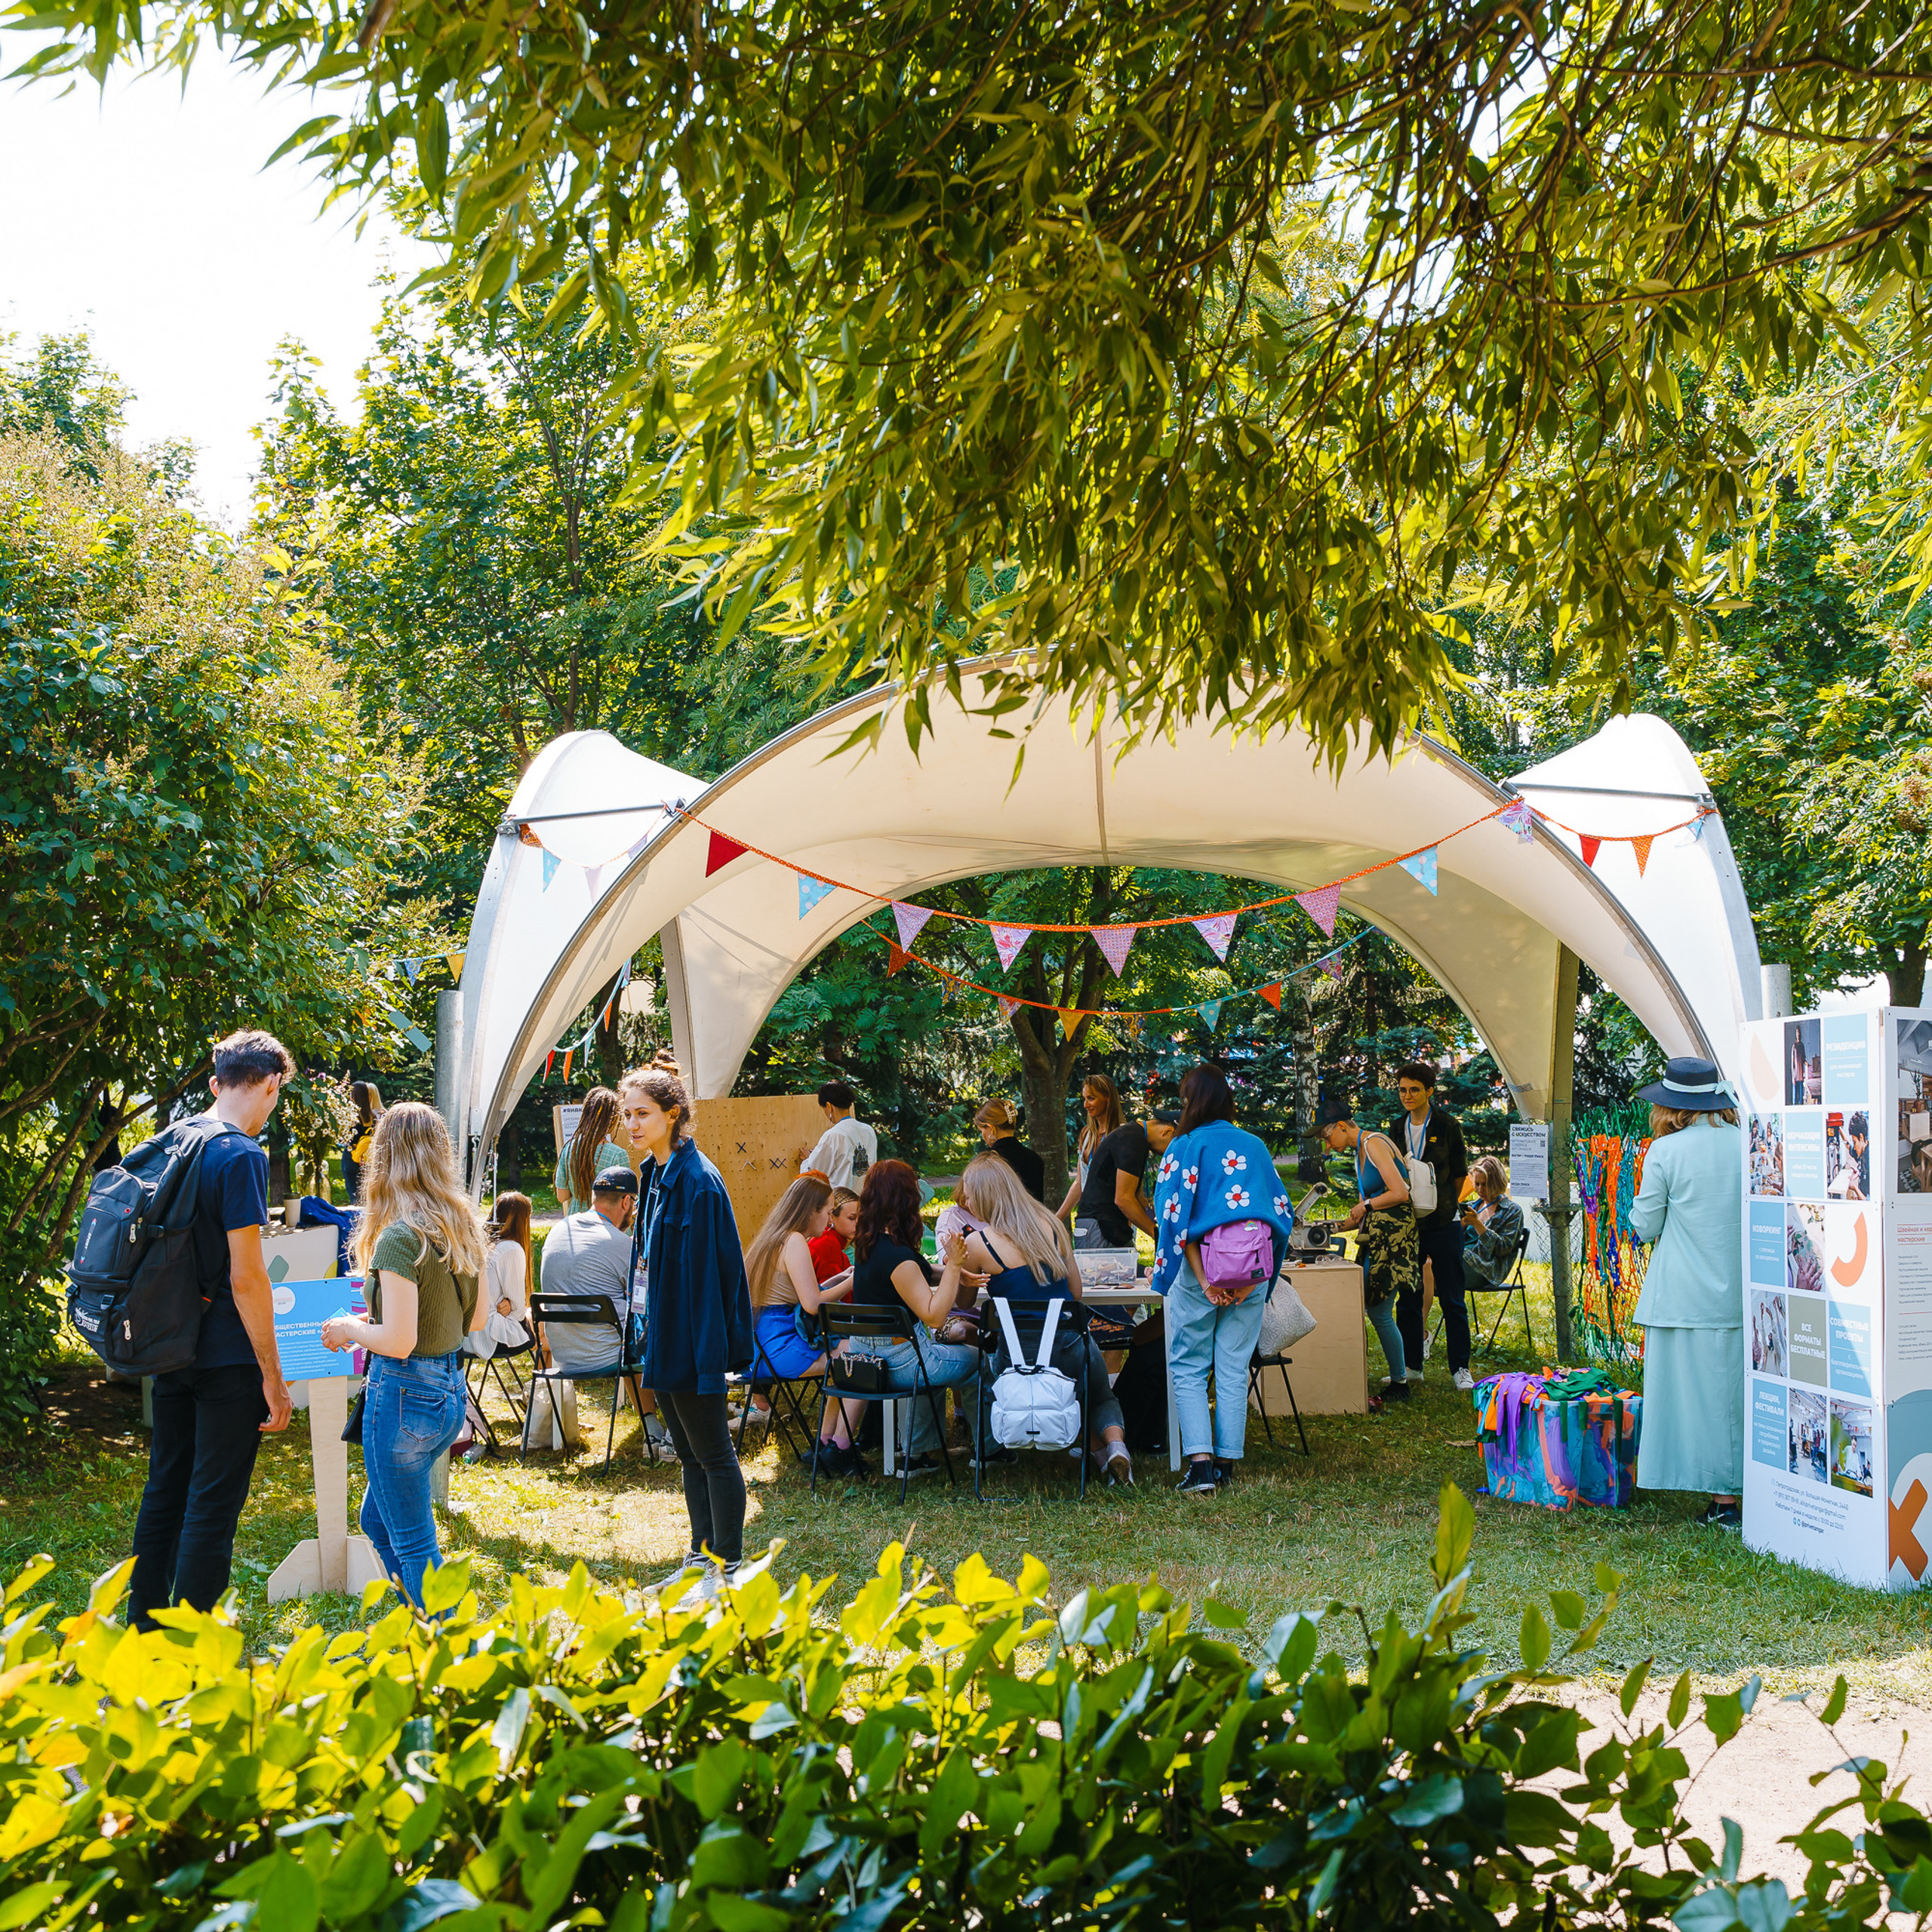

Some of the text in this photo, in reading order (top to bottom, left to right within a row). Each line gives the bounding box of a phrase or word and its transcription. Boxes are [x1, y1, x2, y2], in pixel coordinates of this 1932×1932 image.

[1826, 1041, 1866, 1052] РЕЗИДЕНЦИЯ
[1787, 1131, 1822, 1141] ОБУЧАЮЩИЕ
[1788, 1143, 1820, 1152] ИНТЕНСИВЫ
[1752, 1224, 1782, 1235] КОВОРКИНГ
[275, 1321, 325, 1331] БЩЕСТВЕННЫ
[1801, 1322, 1812, 1333] ВСЕ
[1830, 1317, 1869, 1331] СОВМЕСТНЫЕ
[275, 1330, 315, 1338] АСТЕРСКИЕ
[1835, 1330, 1863, 1343] ПРОЕКТЫ
[1794, 1333, 1822, 1347] ФОРМАТЫ
[1790, 1344, 1826, 1359] БЕСПЛАТНЫЕ
[1759, 1391, 1780, 1405] ЛЕКЦИИ,
[1755, 1401, 1784, 1417] ФЕСТИВАЛИ
